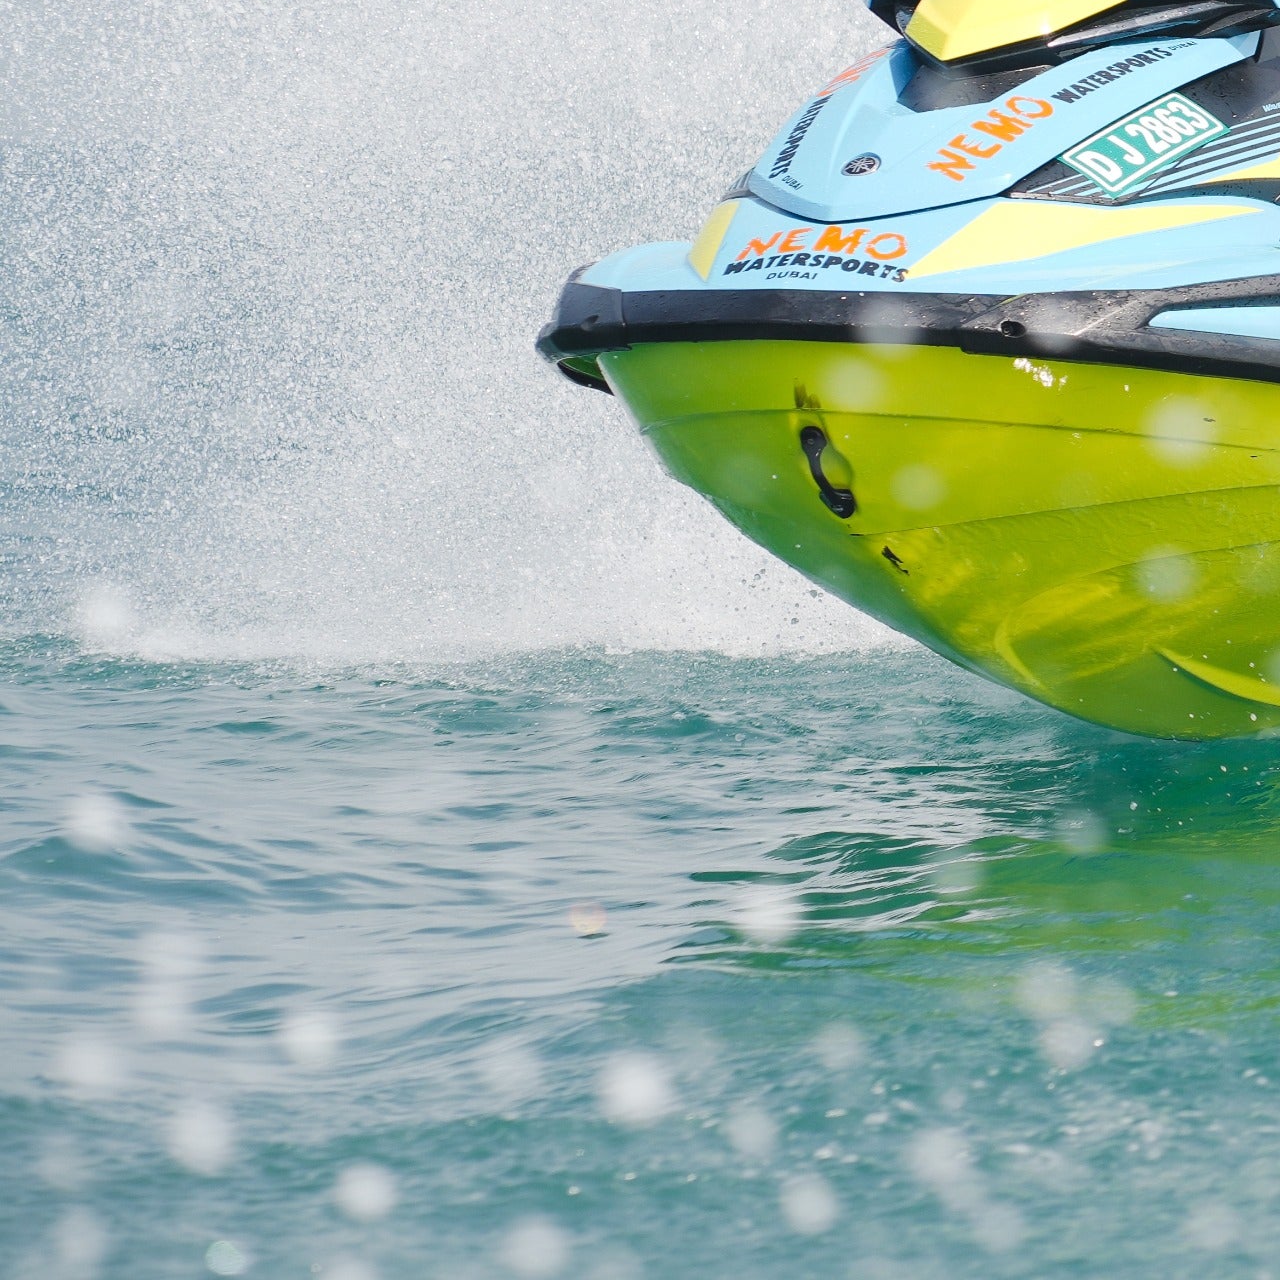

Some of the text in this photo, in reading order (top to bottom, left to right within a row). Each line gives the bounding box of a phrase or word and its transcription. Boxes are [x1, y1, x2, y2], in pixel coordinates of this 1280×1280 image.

[926, 96, 1054, 181] NEMO
[1051, 47, 1173, 104] WATERSPORTS
[1130, 101, 1210, 154] 2863
[781, 175, 804, 190] DUBAI
[736, 226, 908, 260] NEMO
[722, 253, 909, 282] WATERSPORTS
[766, 271, 818, 280] DUBAI
